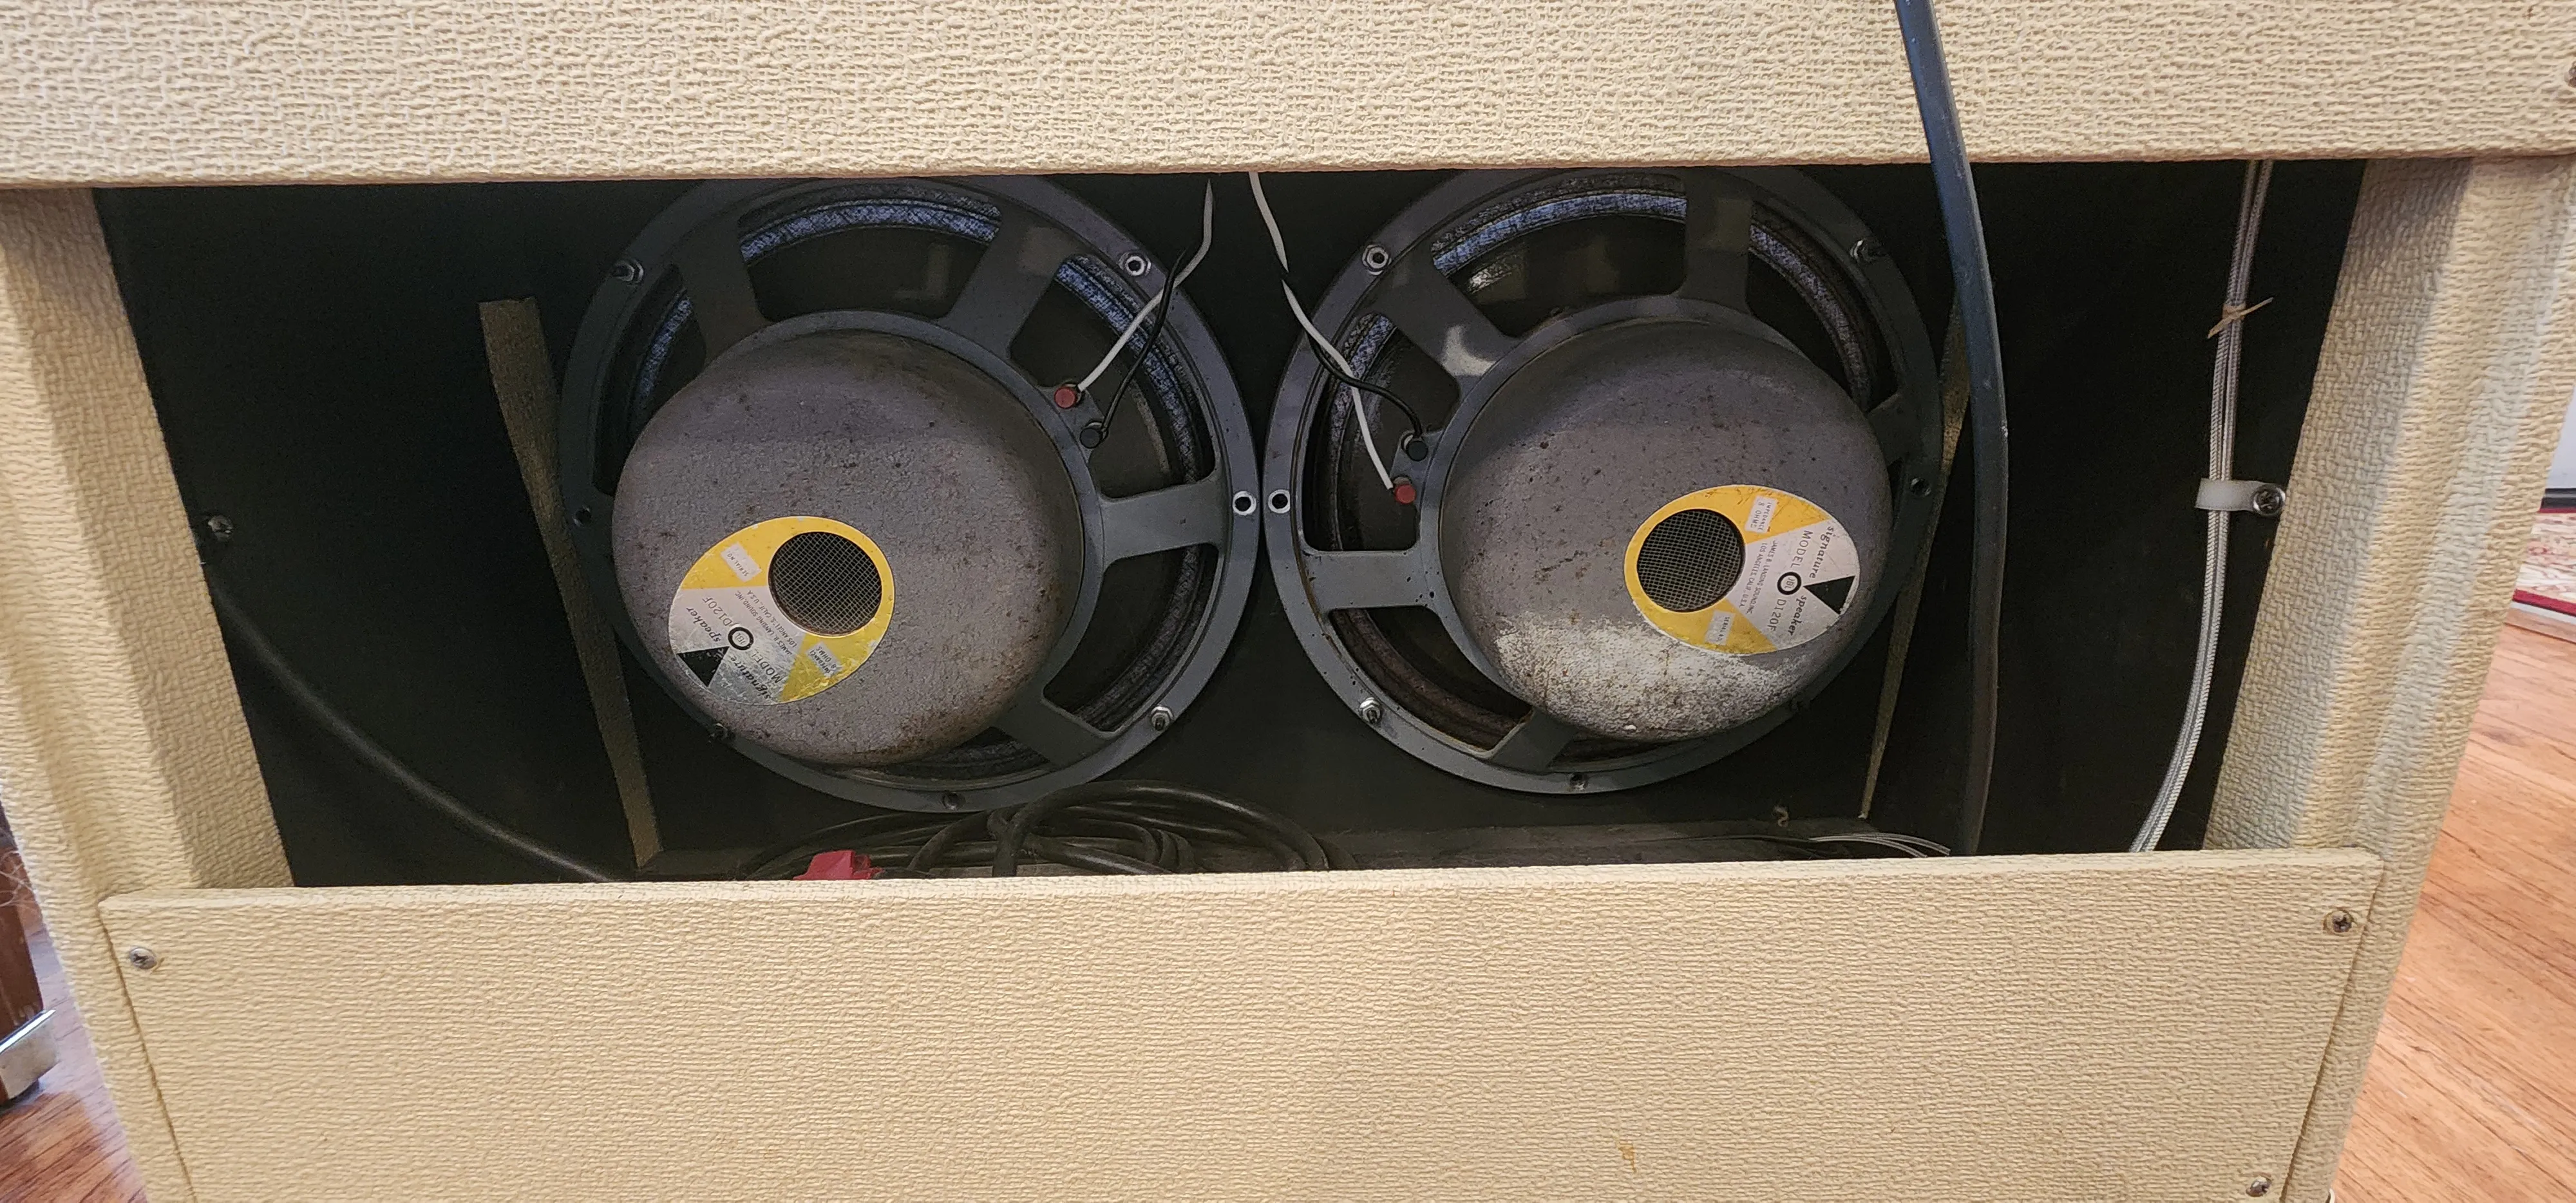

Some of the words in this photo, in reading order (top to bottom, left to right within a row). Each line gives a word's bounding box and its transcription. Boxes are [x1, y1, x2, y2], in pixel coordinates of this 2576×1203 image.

[1768, 540, 1777, 558] JAMES
[1790, 530, 1813, 568] MODEL
[1809, 526, 1835, 578] signature
[1784, 577, 1795, 589] JBL
[686, 607, 721, 642] speaker
[702, 597, 733, 626] D120F
[756, 616, 775, 636] LANSING
[1767, 598, 1786, 631] D120F
[1788, 595, 1806, 636] speaker
[777, 640, 793, 655] JAMES
[787, 638, 797, 647] LOS
[816, 646, 832, 662] OHMS
[730, 655, 771, 699] signature
[752, 649, 782, 683] MODEL
